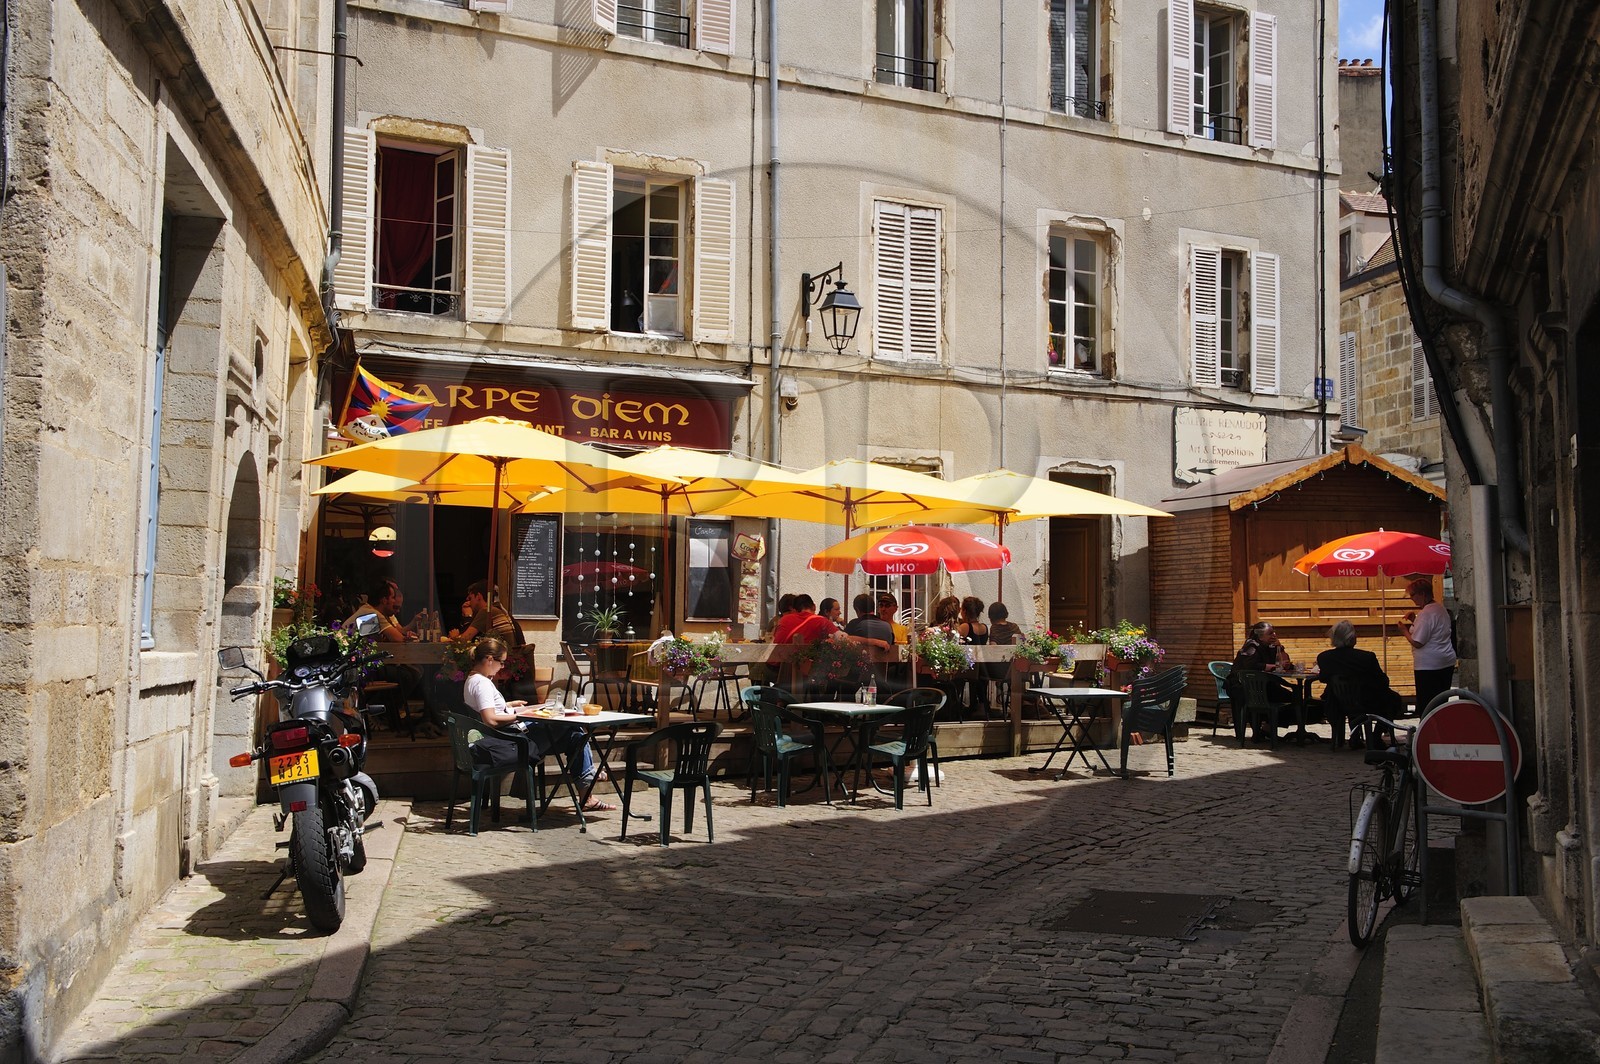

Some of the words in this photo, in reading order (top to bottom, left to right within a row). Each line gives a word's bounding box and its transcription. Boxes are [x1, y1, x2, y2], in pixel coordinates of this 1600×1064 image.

[1218, 418, 1264, 431] RENAUDOT
[590, 427, 619, 440] BAR
[623, 429, 635, 440] A
[637, 430, 672, 443] VINS
[1188, 444, 1200, 454] Art
[1203, 445, 1209, 454] &
[1212, 445, 1255, 457] Expositions
[1198, 457, 1240, 466] Encadrements
[695, 526, 716, 536] Carte
[886, 563, 916, 572] MIKO
[1337, 568, 1363, 576] MIKO
[278, 754, 309, 768] 2233
